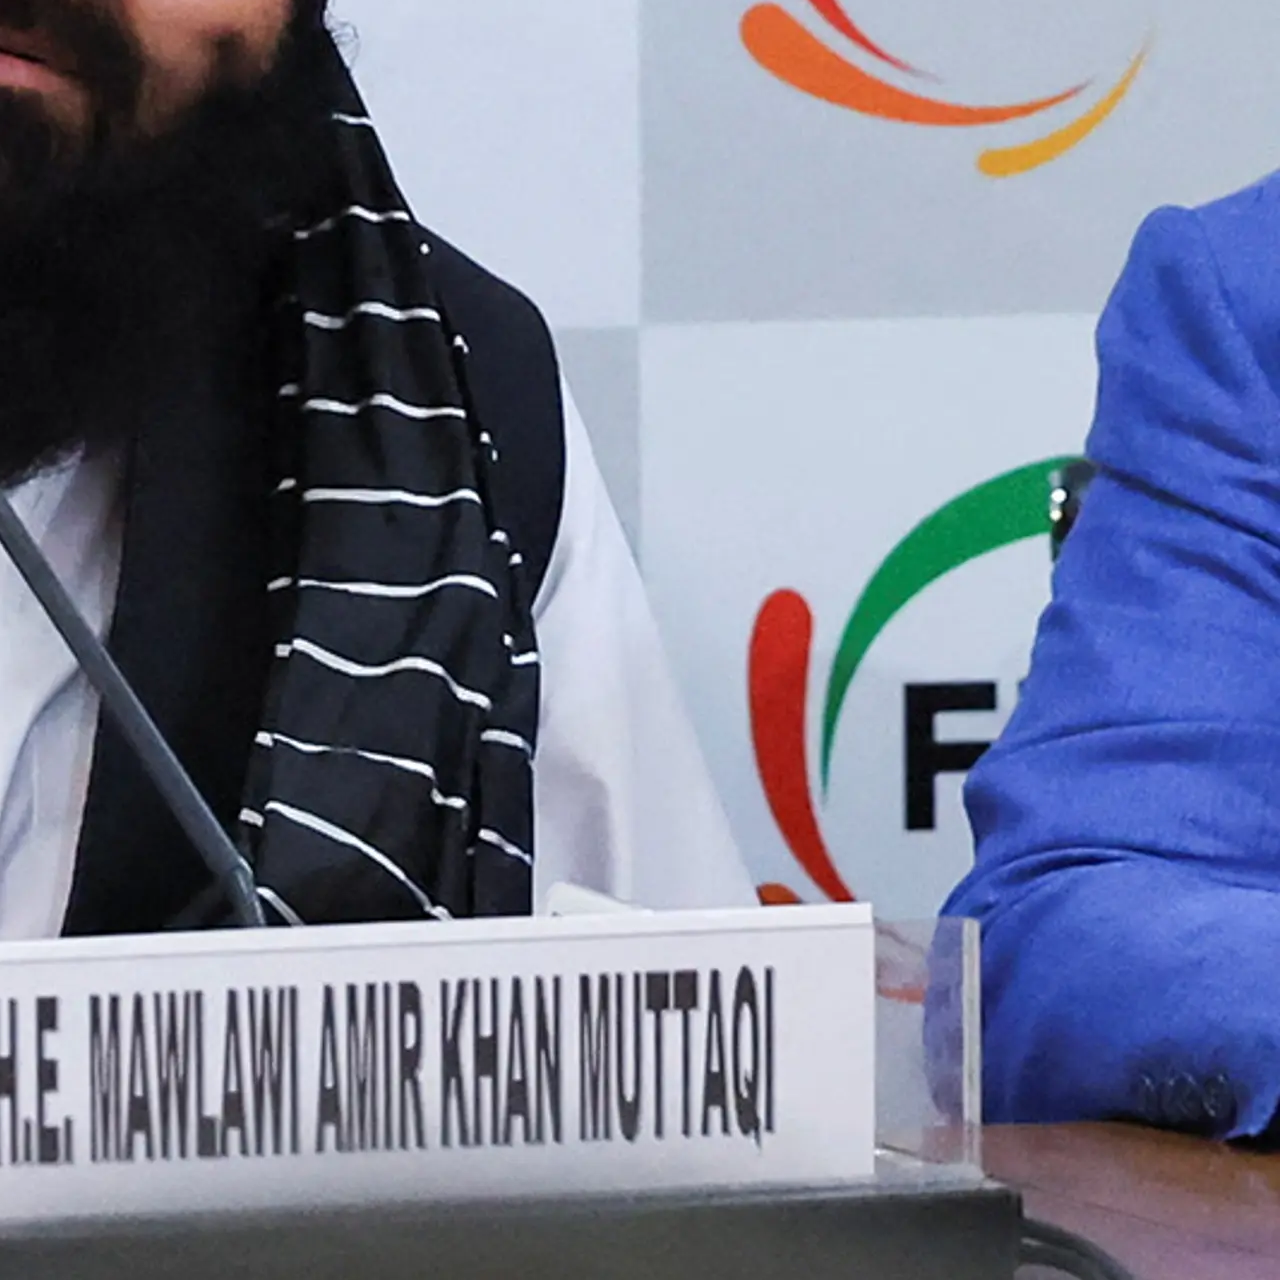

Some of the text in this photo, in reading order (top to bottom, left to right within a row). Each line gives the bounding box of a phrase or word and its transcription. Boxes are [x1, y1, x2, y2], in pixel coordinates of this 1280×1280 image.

[89, 986, 299, 1162] MAWLAWI
[315, 981, 426, 1153] AMIR
[441, 975, 562, 1147] KHAN
[579, 966, 774, 1152] MUTTAQI
